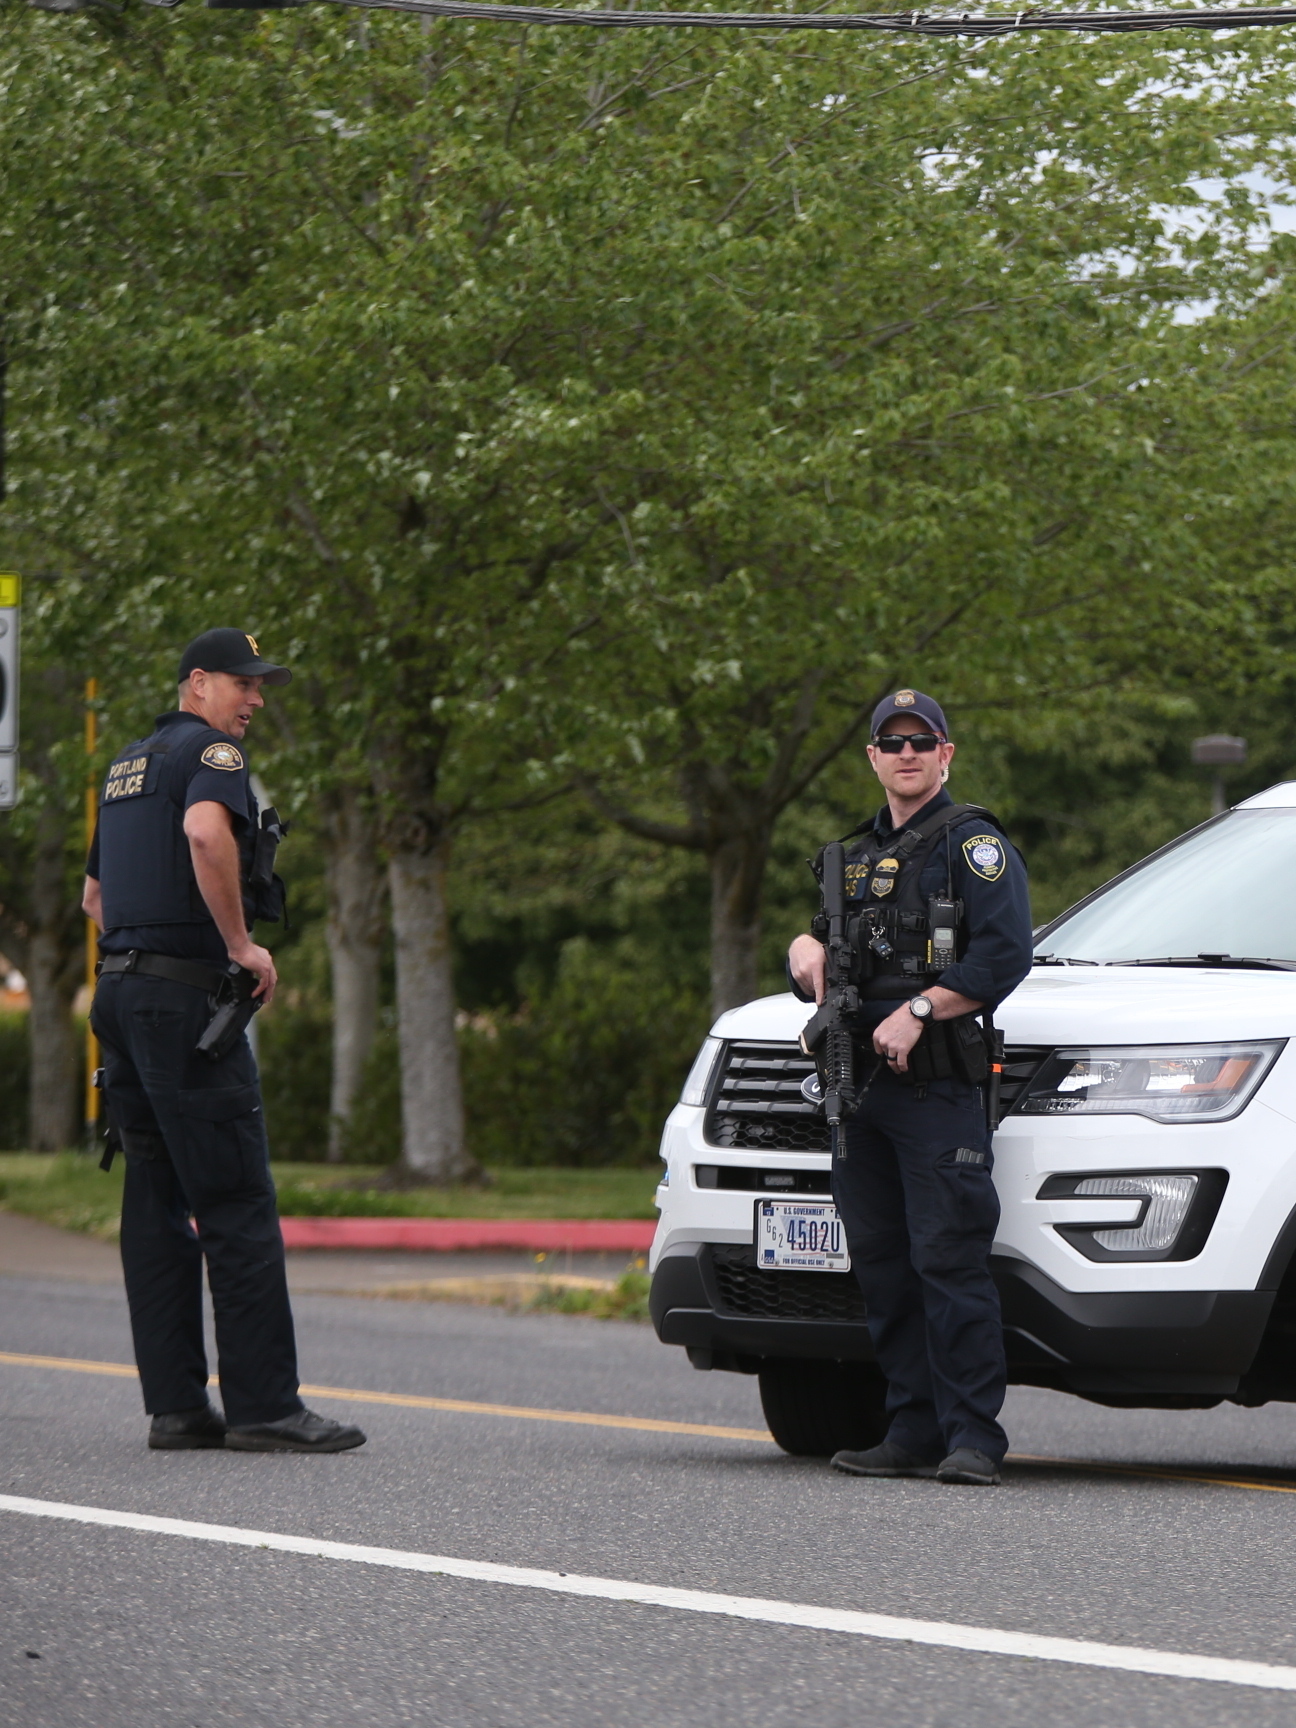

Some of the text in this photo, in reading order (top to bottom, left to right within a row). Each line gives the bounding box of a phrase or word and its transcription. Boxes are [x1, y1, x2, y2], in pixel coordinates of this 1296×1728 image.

[109, 757, 147, 779] PORTLAND
[105, 774, 145, 800] POLICE
[966, 837, 997, 851] POLICE
[845, 863, 869, 878] OLICE
[783, 1207, 792, 1215] U.S.
[793, 1208, 825, 1216] GOVERNMENT
[787, 1220, 840, 1252] 4502U
